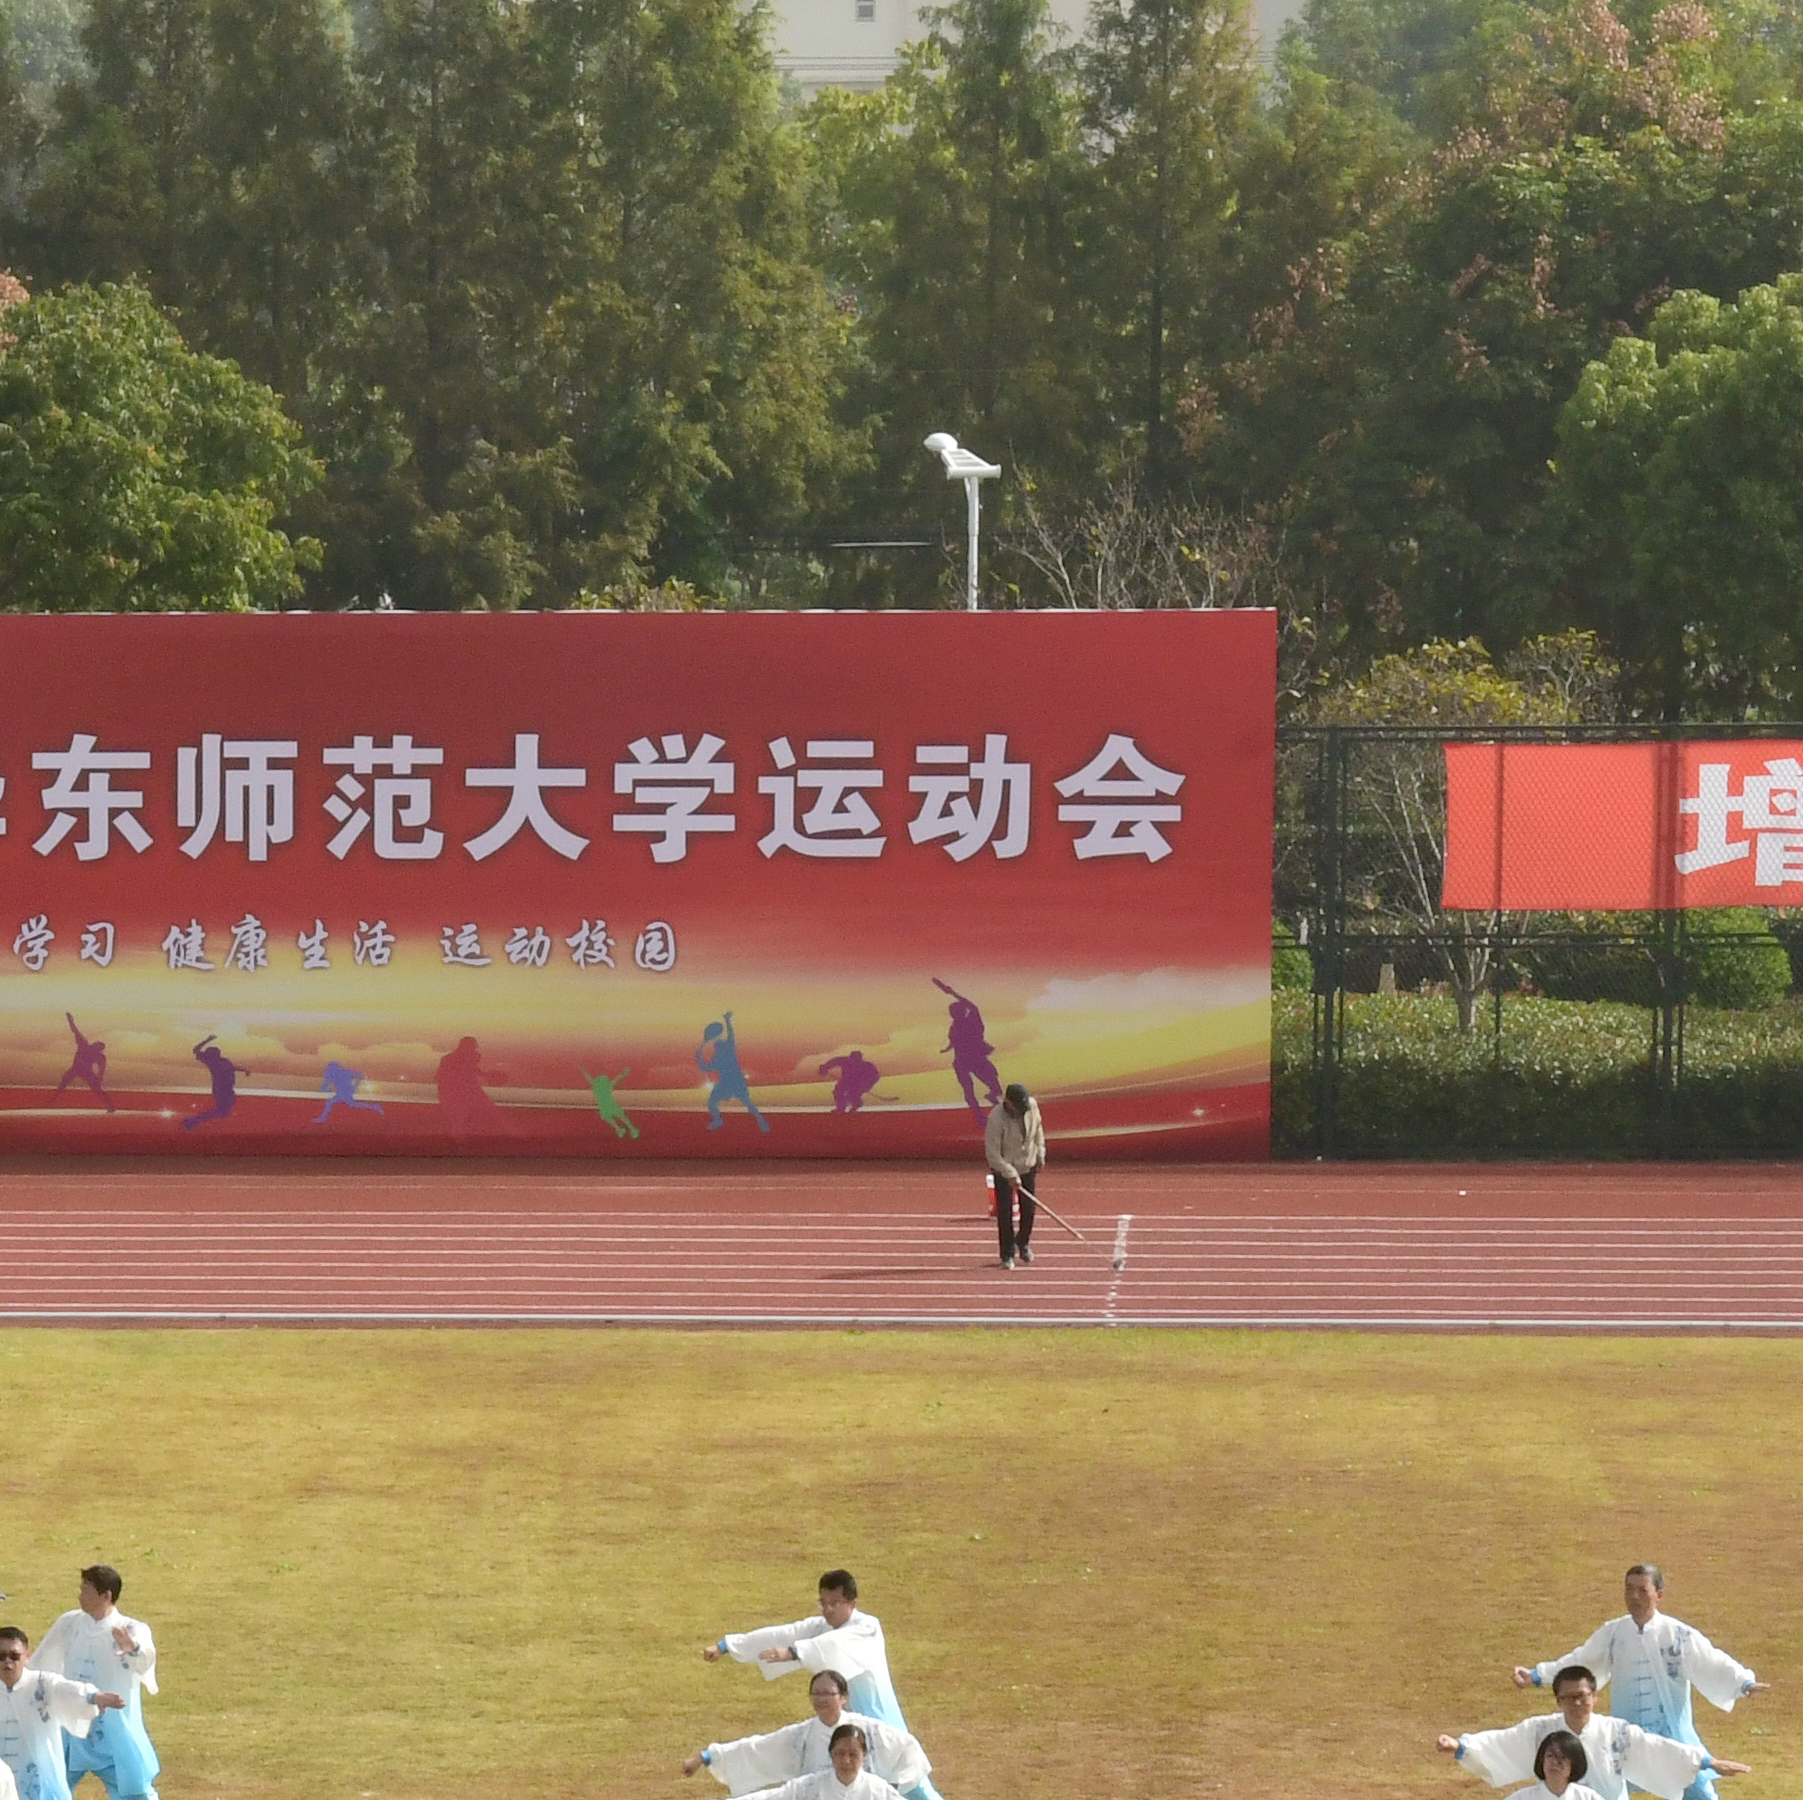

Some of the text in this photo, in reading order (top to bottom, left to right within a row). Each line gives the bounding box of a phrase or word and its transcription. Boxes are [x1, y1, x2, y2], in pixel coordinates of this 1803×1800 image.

[1675, 758, 1803, 886] 增
[162, 913, 396, 972] 健康生活
[440, 919, 676, 971] 运动校园
